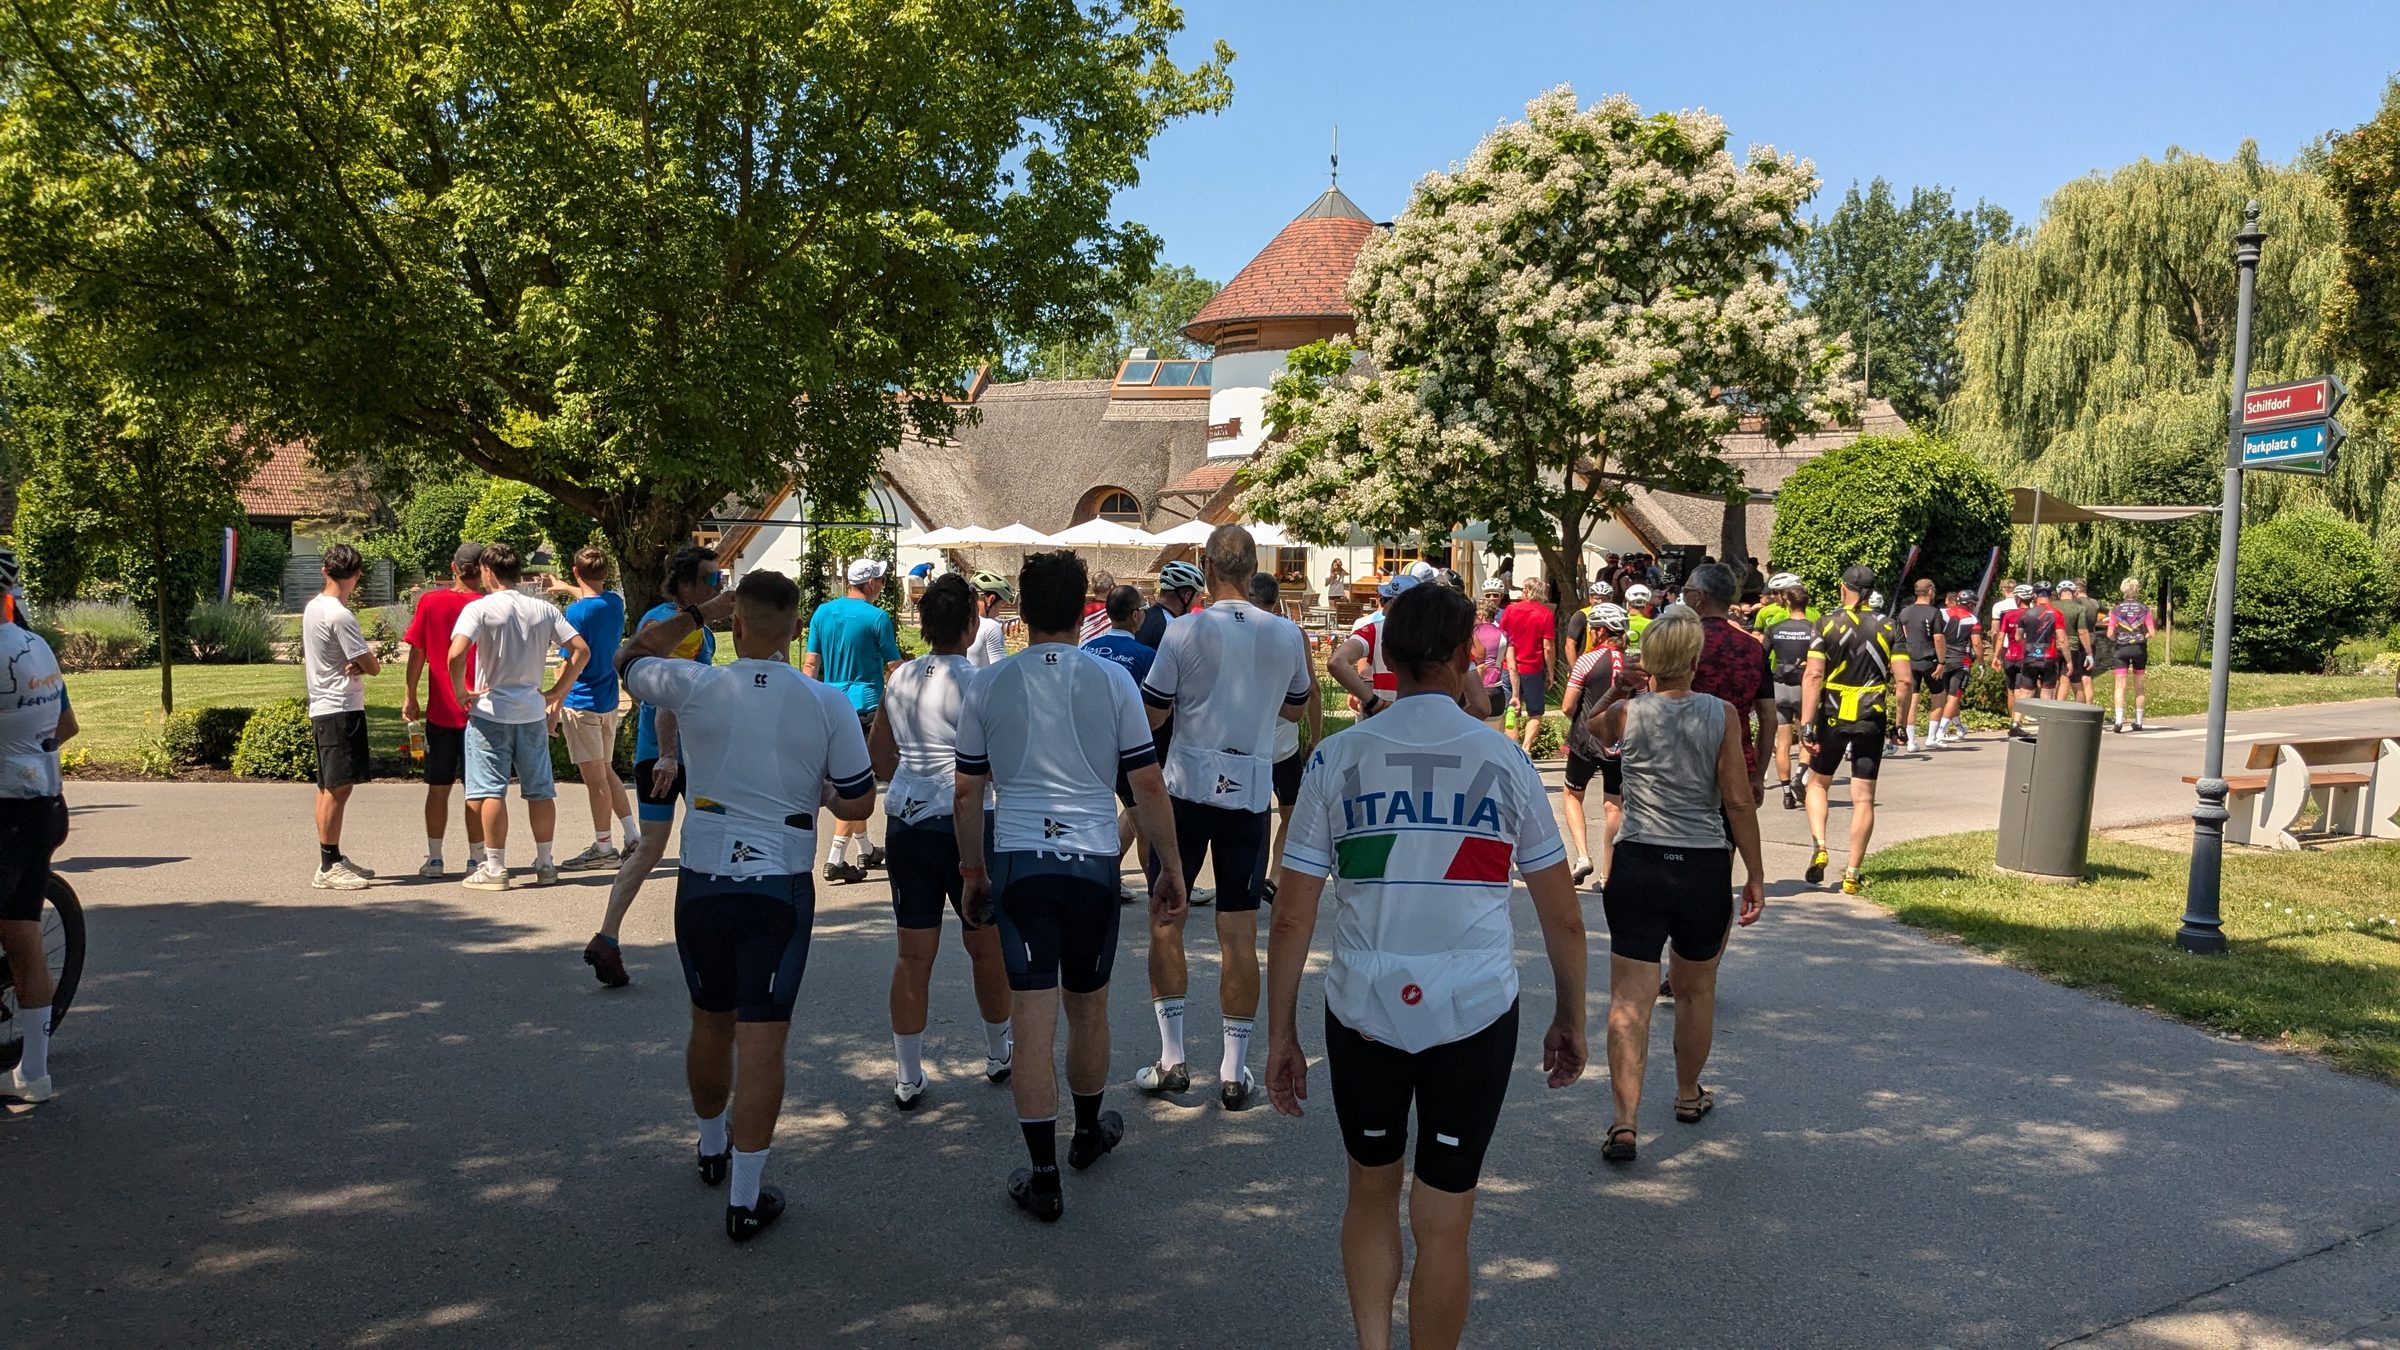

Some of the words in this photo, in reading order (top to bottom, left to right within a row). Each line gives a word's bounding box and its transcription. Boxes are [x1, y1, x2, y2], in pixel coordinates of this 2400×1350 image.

[2247, 395, 2291, 414] Schilfdorf
[2246, 439, 2289, 454] Parkplatz
[2291, 436, 2297, 448] 6
[1343, 790, 1502, 832] ITALIA
[1663, 853, 1684, 861] GORE
